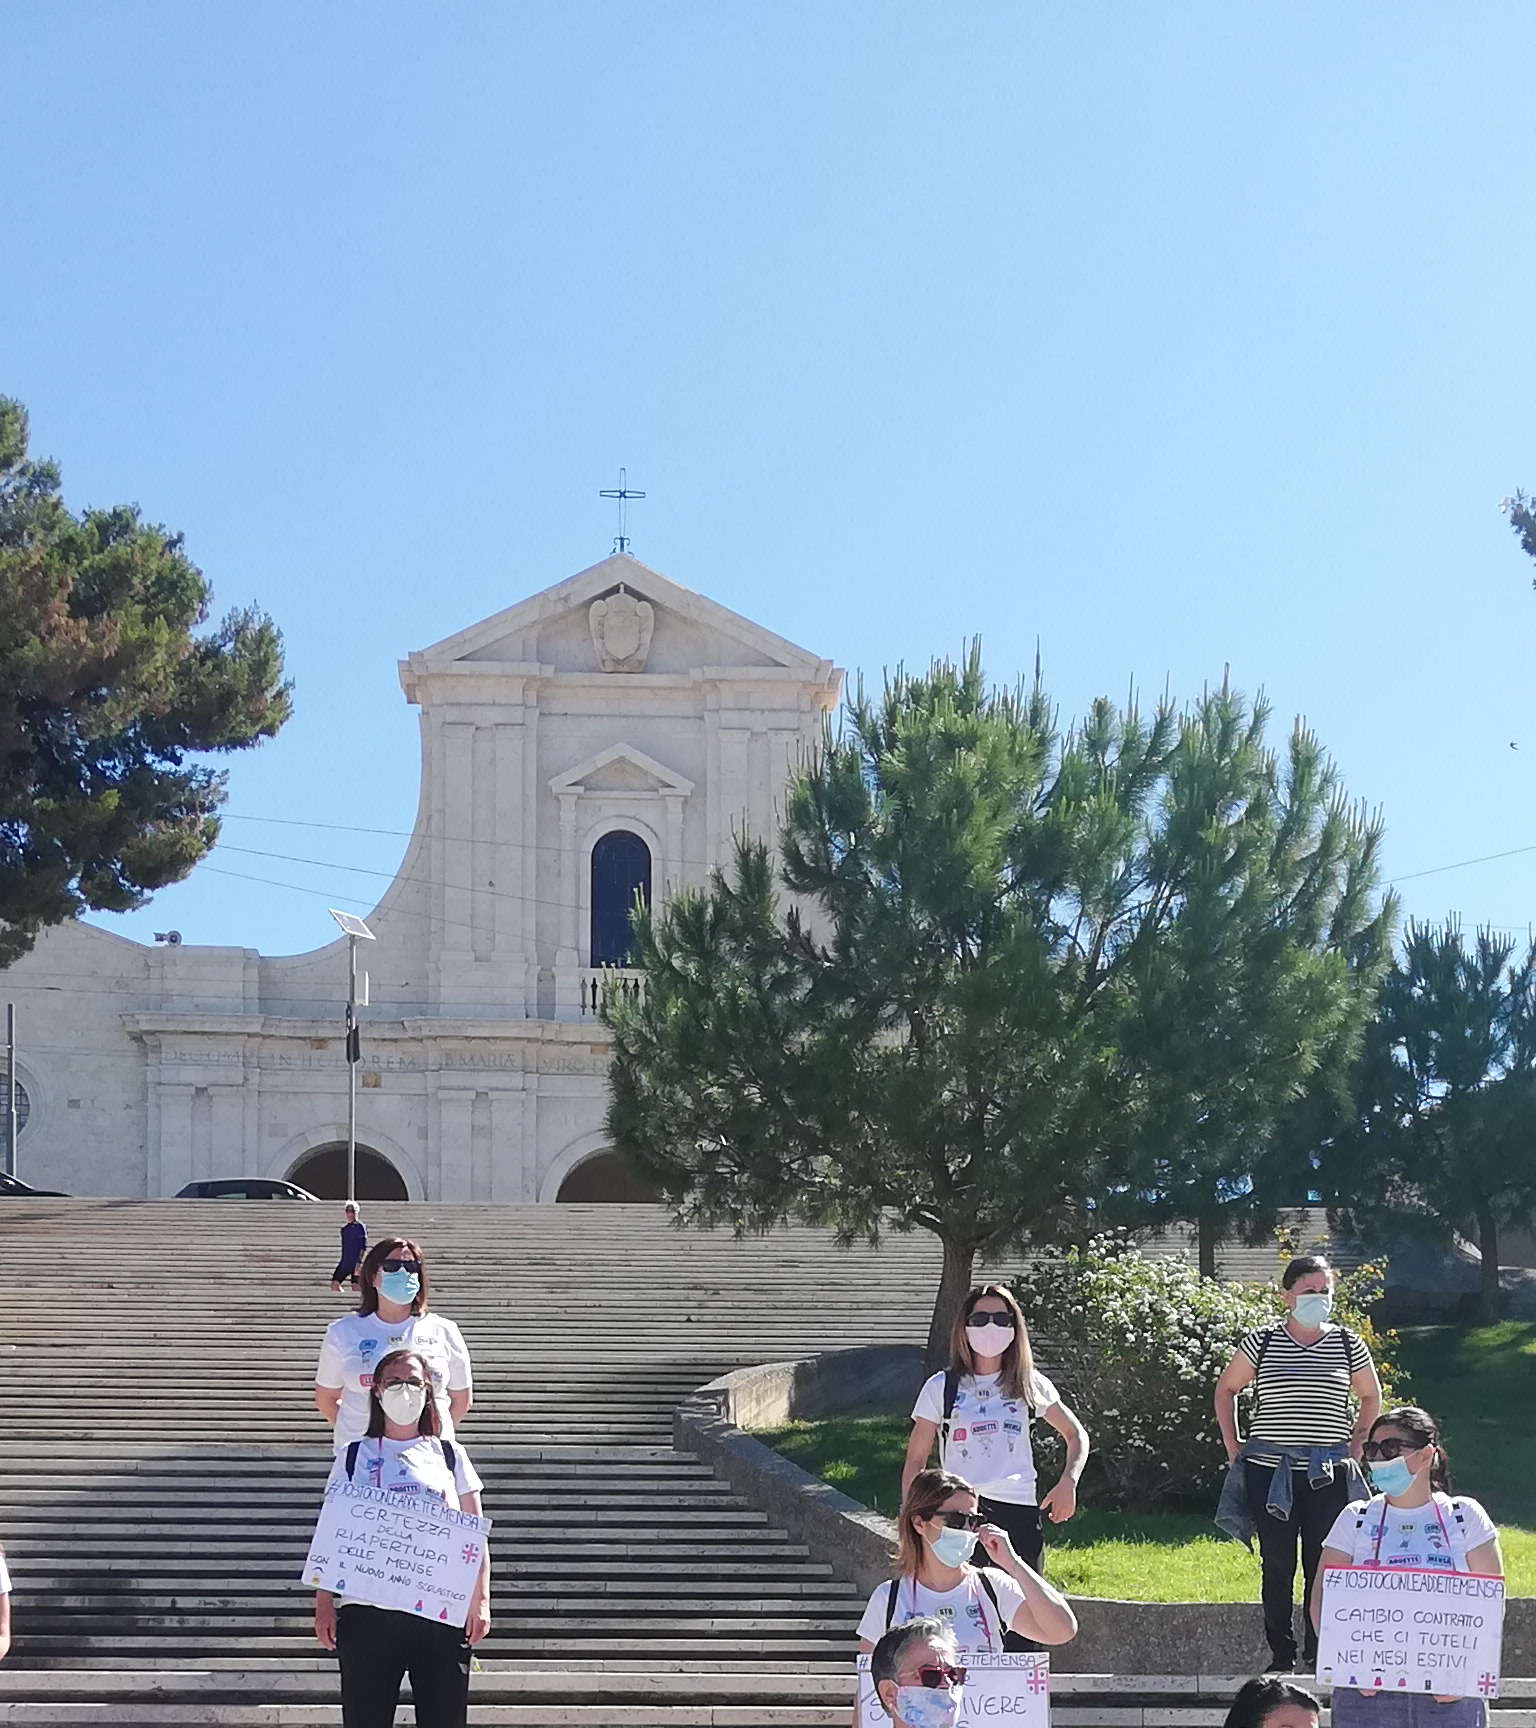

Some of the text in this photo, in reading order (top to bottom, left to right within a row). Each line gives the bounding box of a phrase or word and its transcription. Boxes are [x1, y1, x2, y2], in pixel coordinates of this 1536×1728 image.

[350, 1503, 452, 1540] CERTEZZA
[376, 1524, 414, 1542] DELLA
[335, 1527, 449, 1566] RIAPERTURA
[337, 1545, 434, 1577] DELLE MENSE
[309, 1554, 331, 1566] CON
[415, 1580, 467, 1602] SCOLASTICO
[1325, 1570, 1504, 1600] #IOSTOCONLEADDETTEMENSA
[1334, 1608, 1484, 1628] CAMBIO CONTRATTO
[1350, 1630, 1479, 1650] CHE CI TUTELI
[1337, 1649, 1468, 1669] NEI MESI ESTIVI
